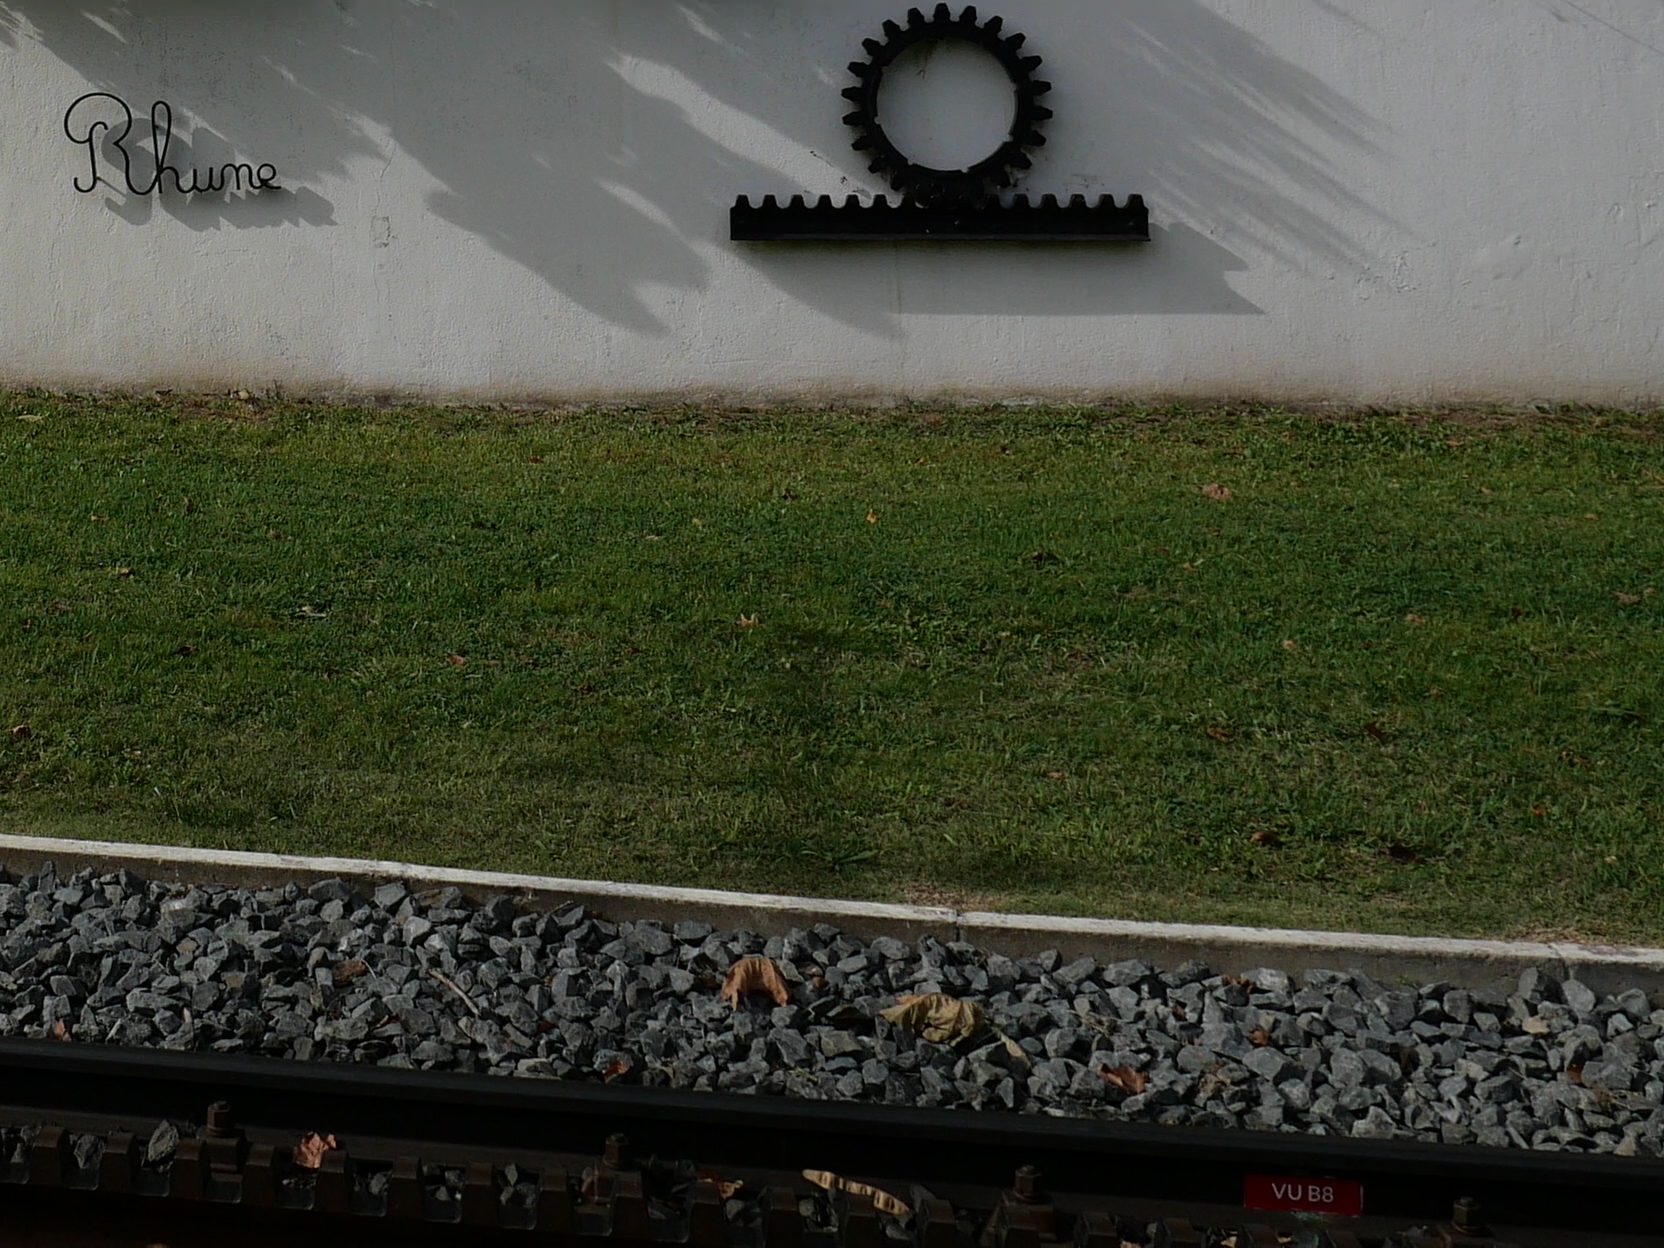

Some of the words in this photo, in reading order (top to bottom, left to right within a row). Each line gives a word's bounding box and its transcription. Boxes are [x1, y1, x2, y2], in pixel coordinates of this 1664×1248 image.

[64, 92, 282, 195] Rhune
[1271, 1183, 1303, 1201] VU
[1307, 1185, 1334, 1203] B8
